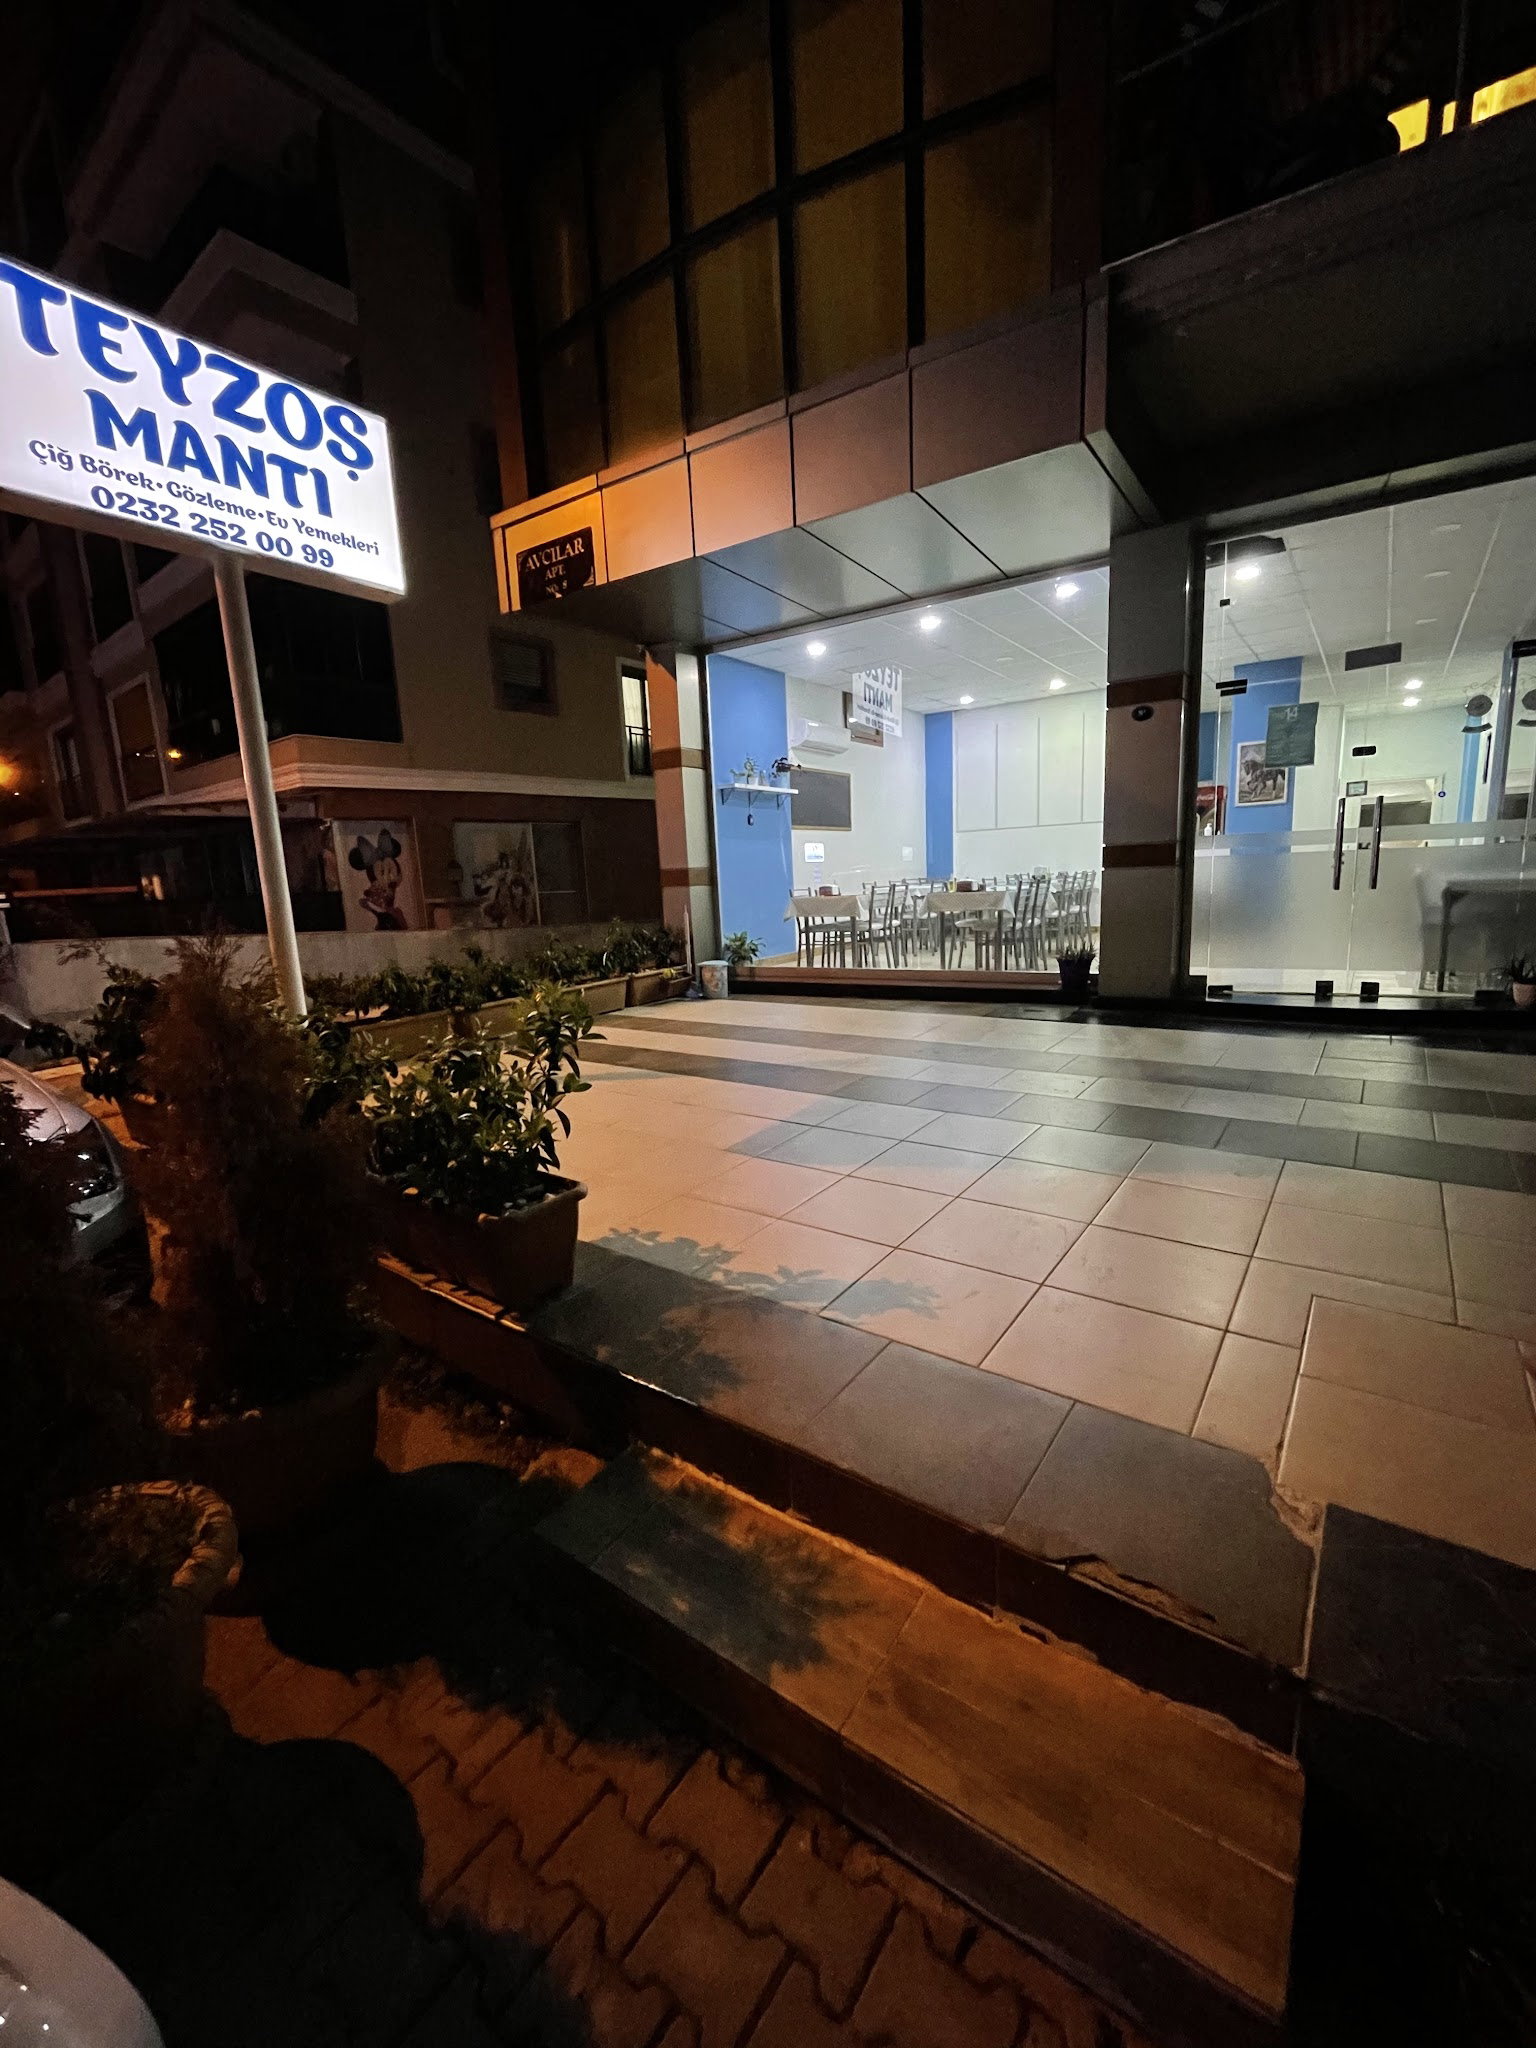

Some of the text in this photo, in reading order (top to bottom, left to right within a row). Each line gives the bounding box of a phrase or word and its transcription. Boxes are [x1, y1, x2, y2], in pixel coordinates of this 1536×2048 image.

[0, 262, 374, 482] TEYZOŞ
[29, 440, 74, 471] Çiğ
[266, 510, 288, 529] Ev
[292, 517, 380, 555] Yemekleri
[83, 389, 333, 518] MANTI
[91, 485, 334, 568] 0232 252 00 99
[526, 537, 585, 570] AVCILAR
